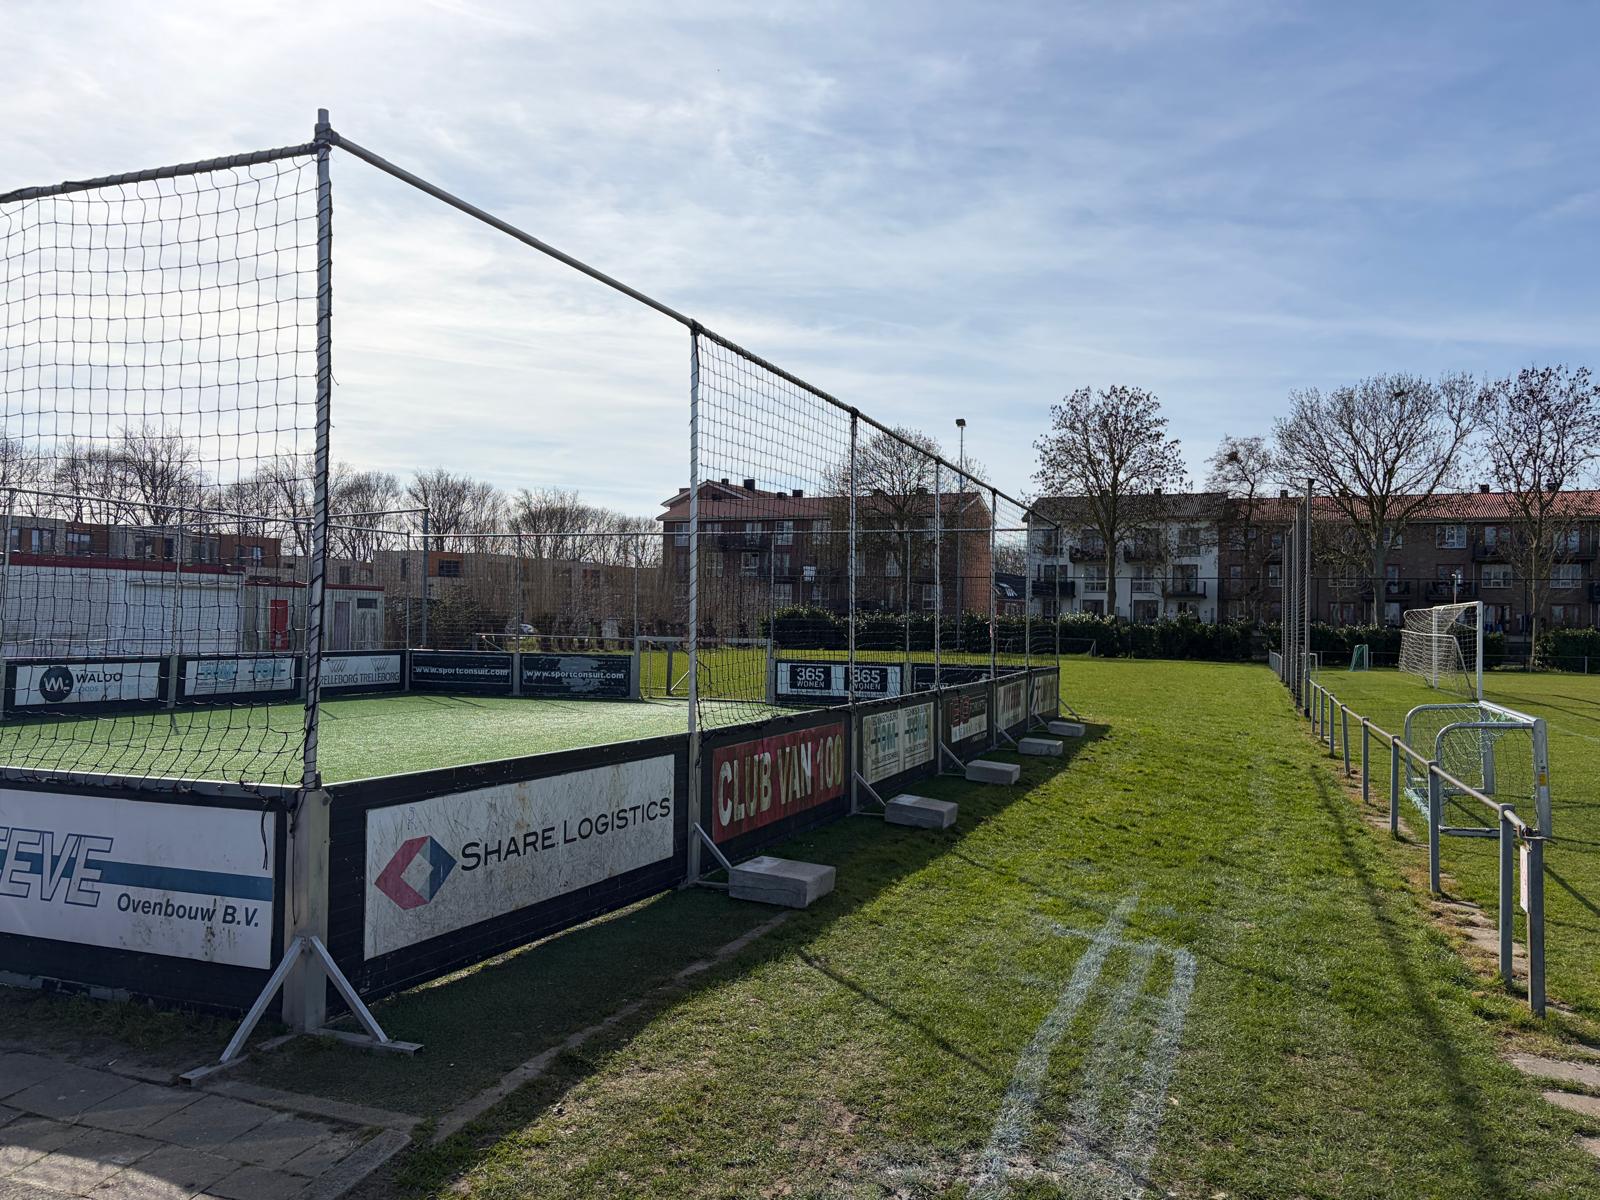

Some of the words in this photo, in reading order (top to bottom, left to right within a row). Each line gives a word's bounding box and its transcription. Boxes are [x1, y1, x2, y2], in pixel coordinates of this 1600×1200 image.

[360, 671, 400, 683] TRELLEBORG
[796, 667, 825, 681] 365
[853, 669, 881, 683] 365
[718, 751, 772, 827] CLUB
[777, 741, 812, 805] VAN
[817, 734, 842, 790] 100
[461, 826, 556, 871] SHARE
[563, 797, 671, 844] LOGISTICS
[117, 892, 217, 922] Ovenbouw
[222, 904, 260, 928] B.V.
